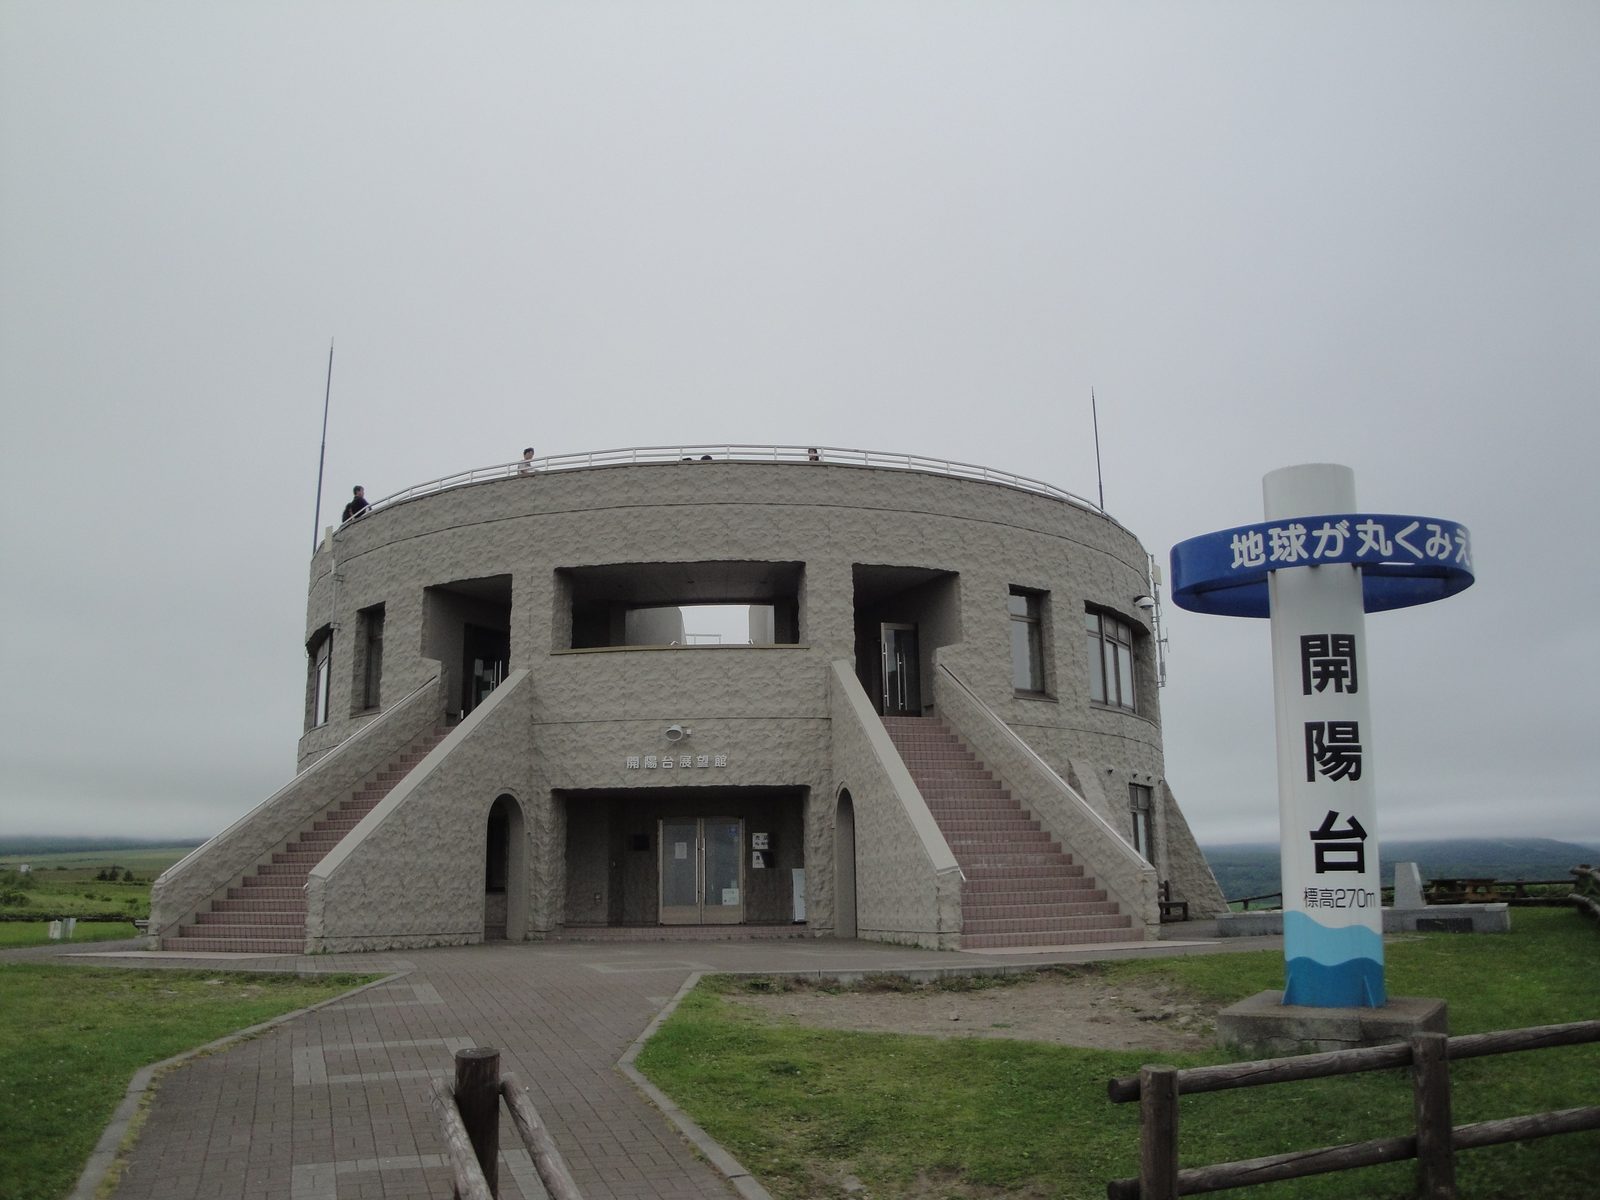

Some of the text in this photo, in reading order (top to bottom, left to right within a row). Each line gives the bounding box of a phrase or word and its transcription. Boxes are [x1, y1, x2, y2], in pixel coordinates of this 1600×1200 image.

[626, 754, 728, 769] 開陽台展望館
[1300, 633, 1368, 874] 開陽台
[1303, 887, 1376, 909] 標高270m
